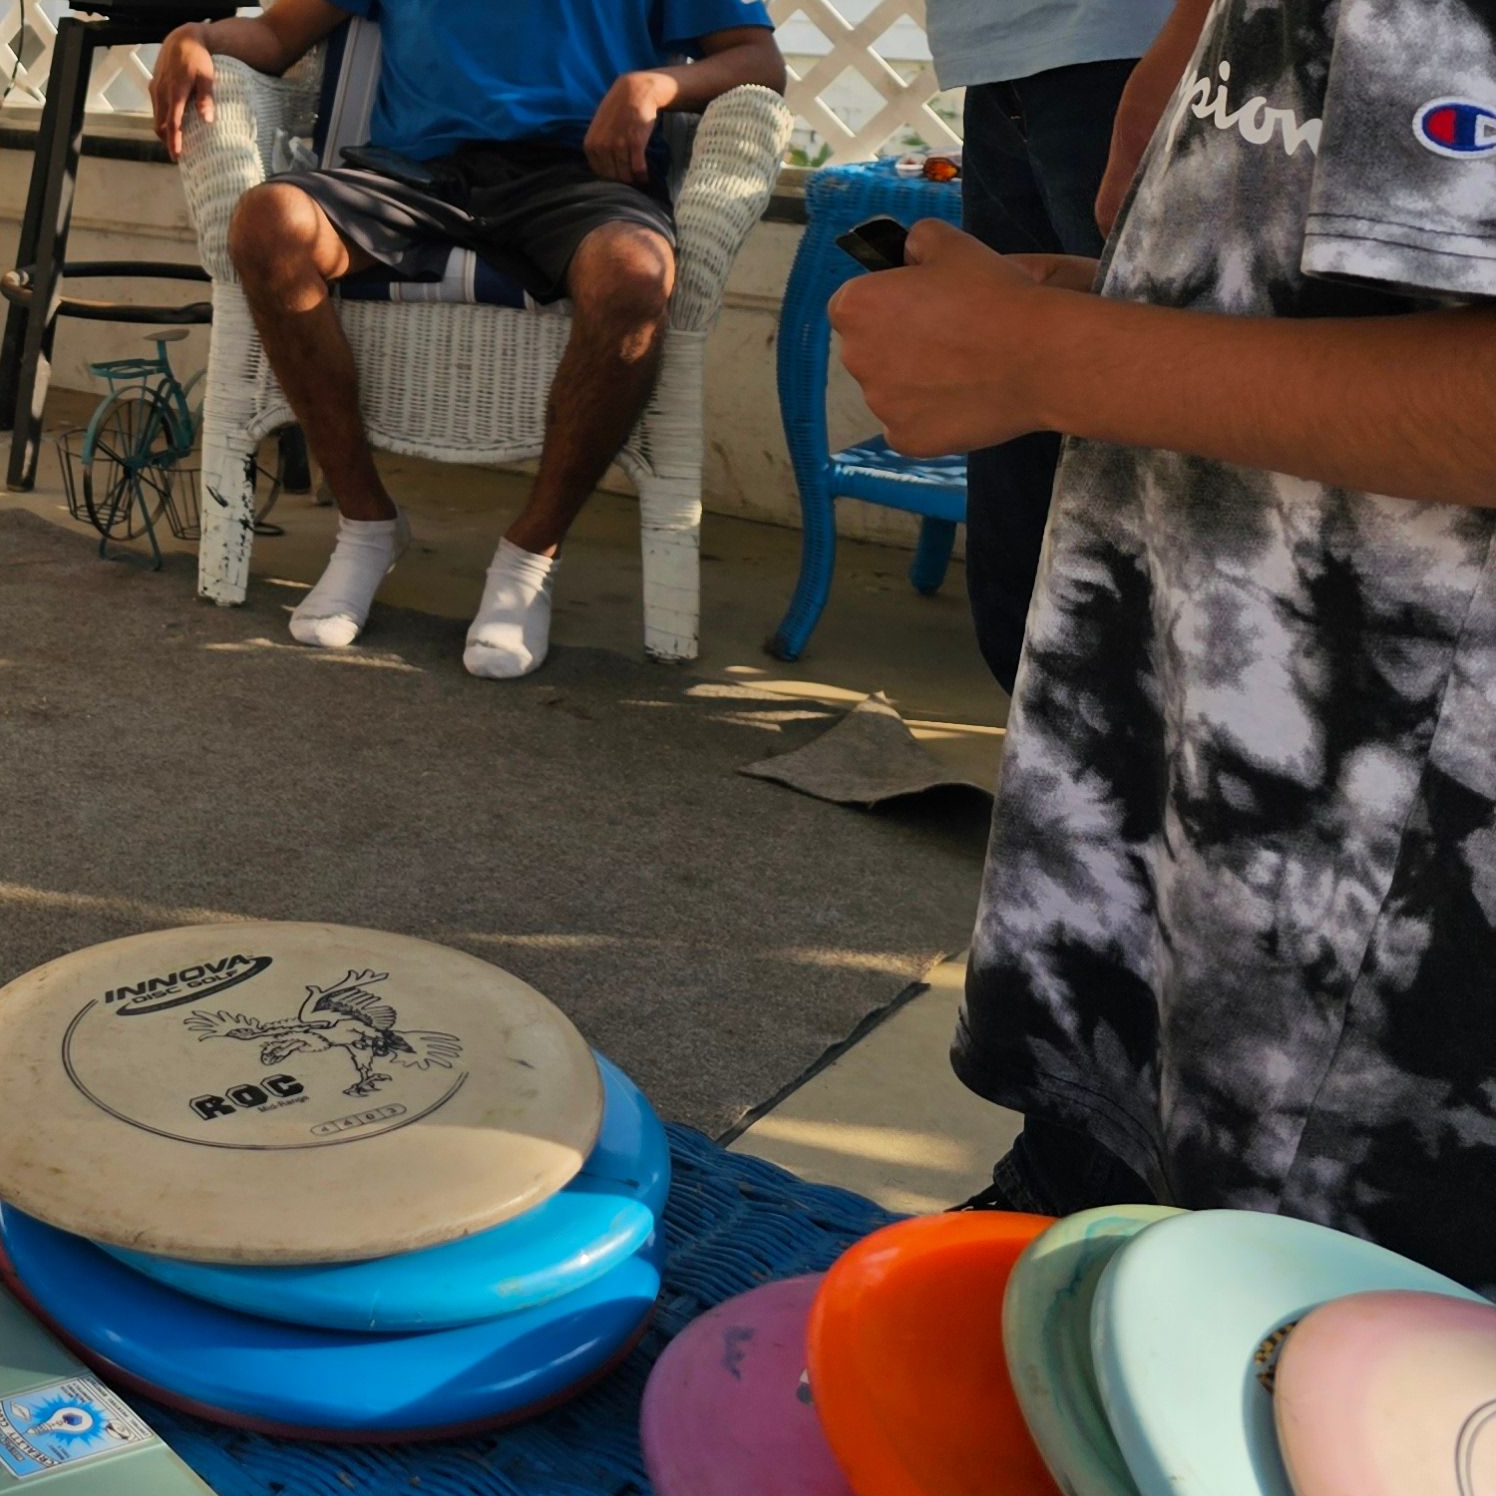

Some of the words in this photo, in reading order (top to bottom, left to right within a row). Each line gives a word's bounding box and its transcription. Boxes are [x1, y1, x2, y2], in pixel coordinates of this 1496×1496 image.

[105, 954, 251, 1004] INNOVA
[131, 985, 183, 1004] DISC
[187, 968, 239, 989] GOLF
[189, 1073, 304, 1121] ROC
[259, 1094, 310, 1114] Mid-Range
